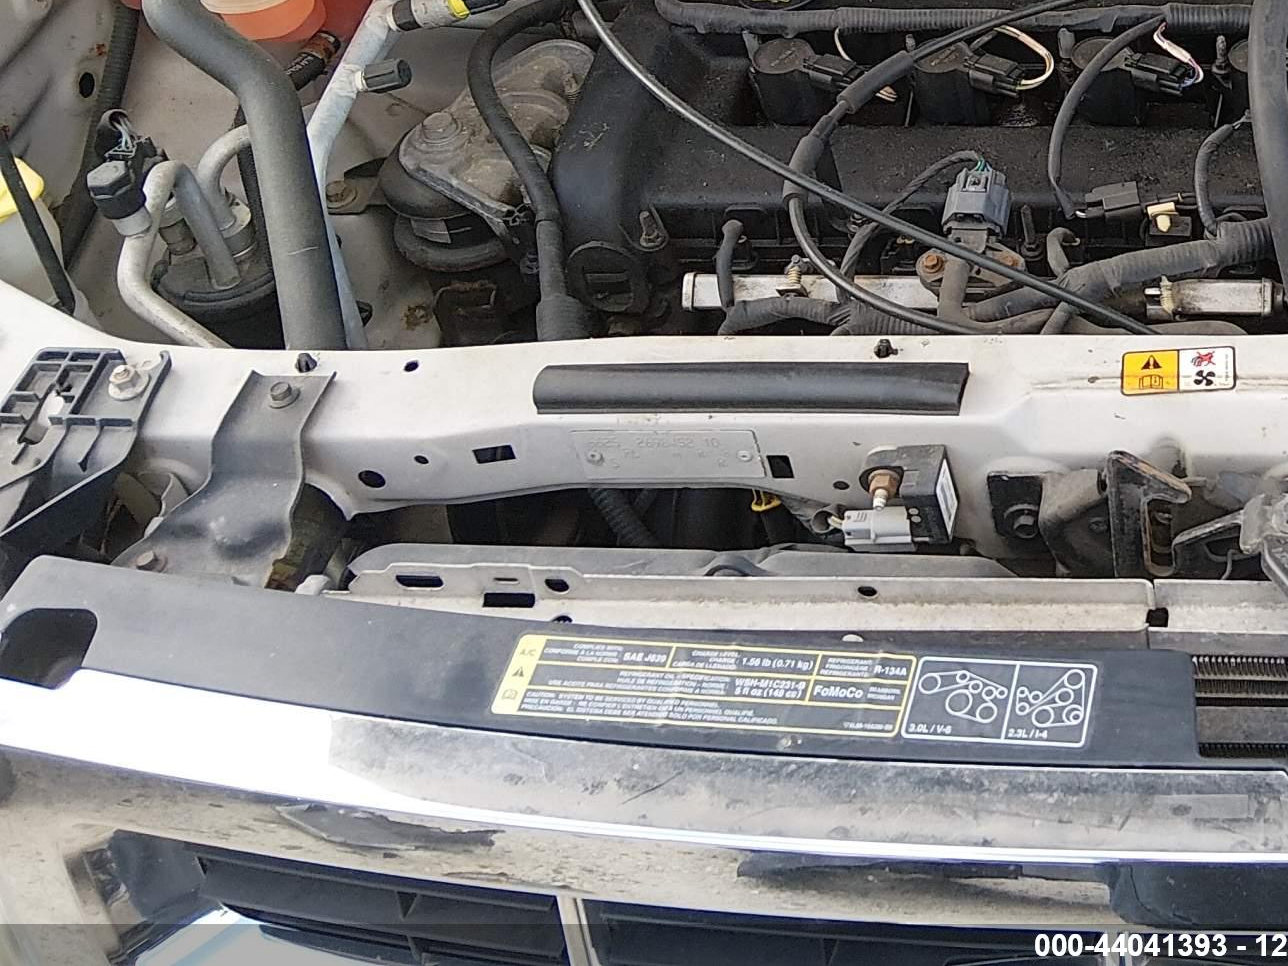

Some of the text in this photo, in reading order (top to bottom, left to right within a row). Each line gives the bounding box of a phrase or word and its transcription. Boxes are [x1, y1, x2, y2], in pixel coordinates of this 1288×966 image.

[623, 652, 667, 663] SAE J639
[761, 657, 772, 667] lb
[772, 658, 795, 668] (0.71
[796, 659, 814, 671] kg)
[873, 665, 907, 676] R-134A
[813, 685, 864, 699] FoMoCo
[907, 722, 929, 733] 3.0L
[936, 724, 952, 735] V-6
[1007, 727, 1029, 739] 2.3L
